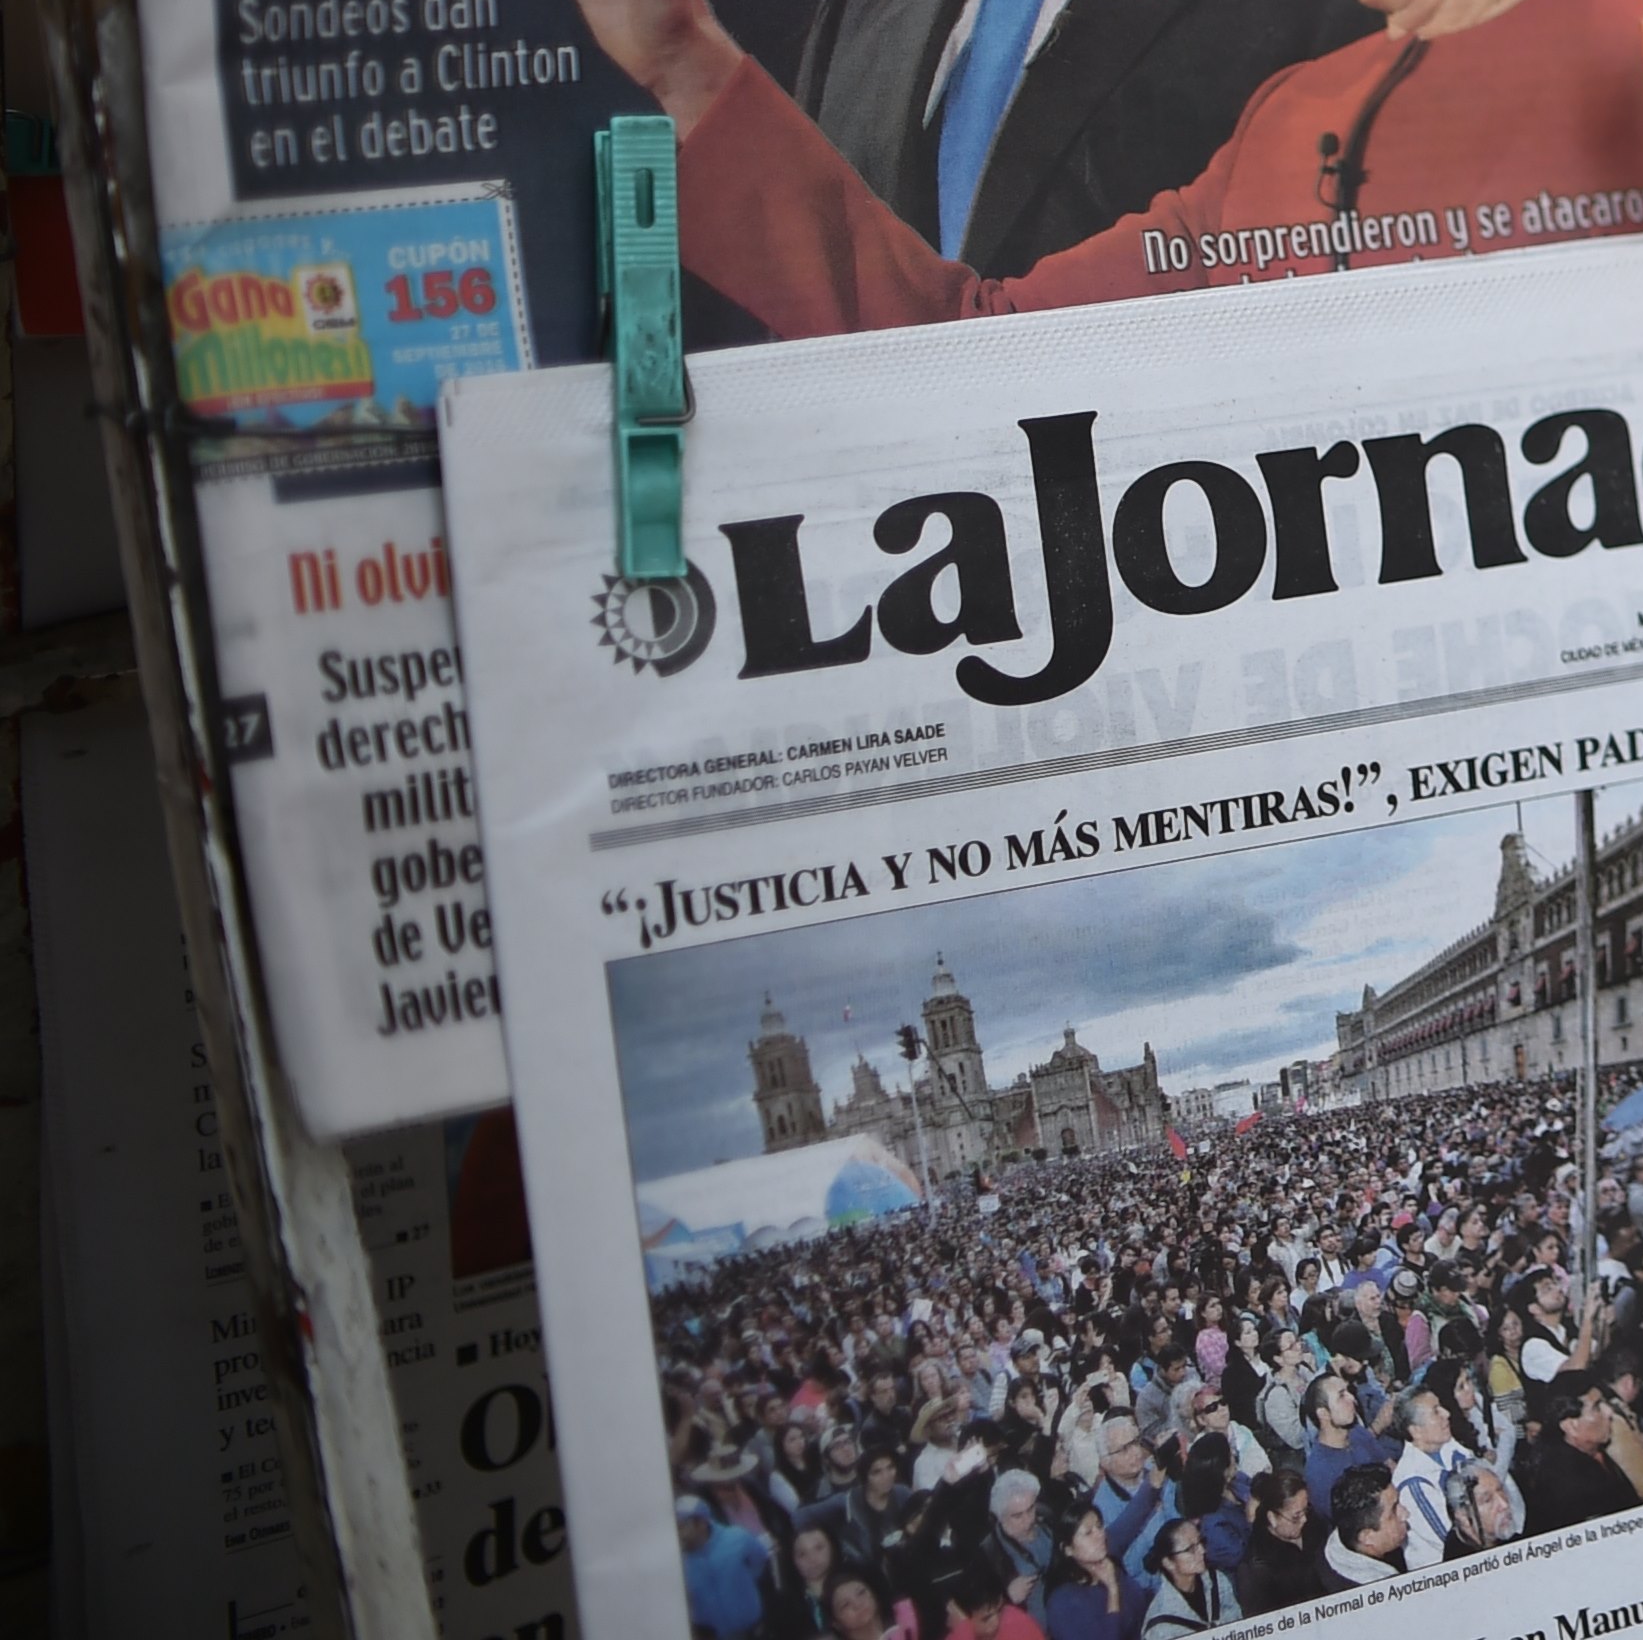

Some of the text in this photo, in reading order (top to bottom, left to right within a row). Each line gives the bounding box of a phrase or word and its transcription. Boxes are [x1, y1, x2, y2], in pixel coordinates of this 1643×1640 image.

[241, 40, 581, 105] triunfo a Clinton
[250, 107, 498, 168] en el debate
[388, 236, 490, 269] CUPÓN
[1143, 230, 1189, 273] No
[1200, 212, 1438, 270] sorprendieron
[1446, 212, 1470, 248] y
[1479, 205, 1513, 237] se
[385, 267, 496, 323] 156
[608, 722, 946, 789] DIRECTORA GENERAL: CARMEN LIRA SAADE
[611, 746, 948, 814] DIRECTOR FUNDADOR: CARLOS VELVER
[881, 851, 912, 891] Y
[927, 838, 991, 885] NO
[1005, 809, 1102, 872] MÁS
[1408, 742, 1564, 803] EXIGEN
[371, 913, 423, 968] de
[1278, 1616, 1295, 1634] de
[1298, 1610, 1311, 1625] la
[1315, 1594, 1364, 1621] Normal
[1367, 1589, 1385, 1607] de
[1387, 1569, 1460, 1601] Ayotzinapa
[1462, 1554, 1500, 1582] partió
[1502, 1547, 1523, 1568] del
[1525, 1536, 1563, 1561] Ángel
[1565, 1531, 1582, 1548] de
